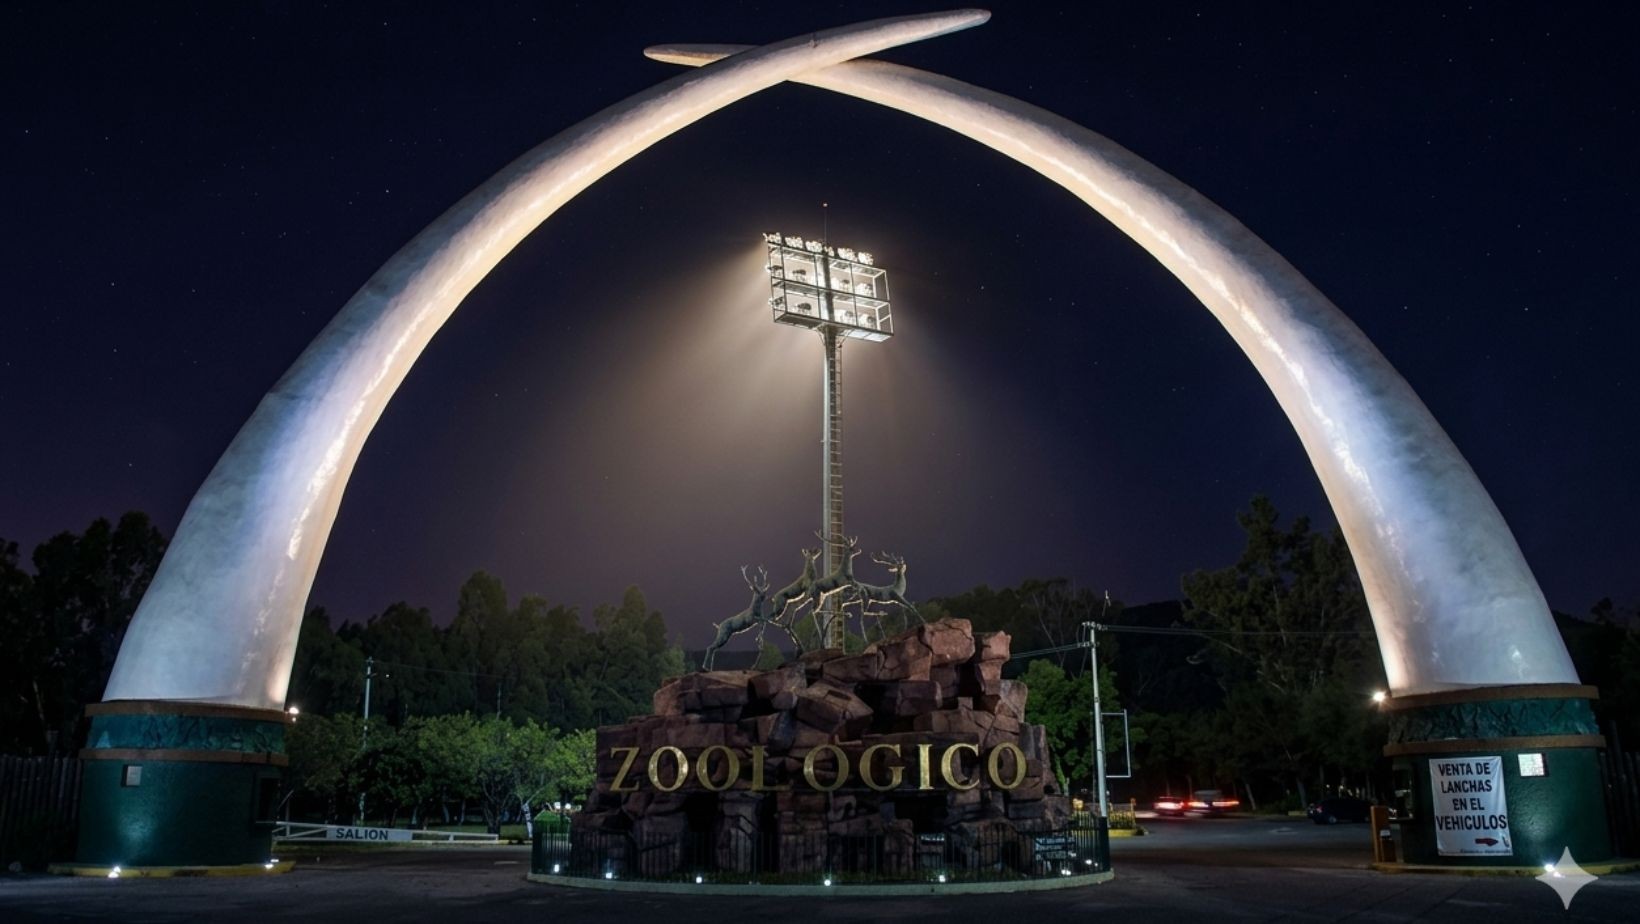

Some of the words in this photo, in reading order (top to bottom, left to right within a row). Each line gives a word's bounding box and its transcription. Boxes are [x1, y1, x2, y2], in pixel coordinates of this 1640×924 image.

[609, 742, 1027, 792] ZOOLOGICO
[1438, 763, 1473, 776] VENTA
[1476, 762, 1491, 775] DE
[1441, 779, 1492, 794] LANCHAS
[1453, 798, 1467, 811] EN
[1470, 798, 1485, 811] EL
[1436, 815, 1507, 831] VEHICULOS
[336, 828, 389, 840] SALION
